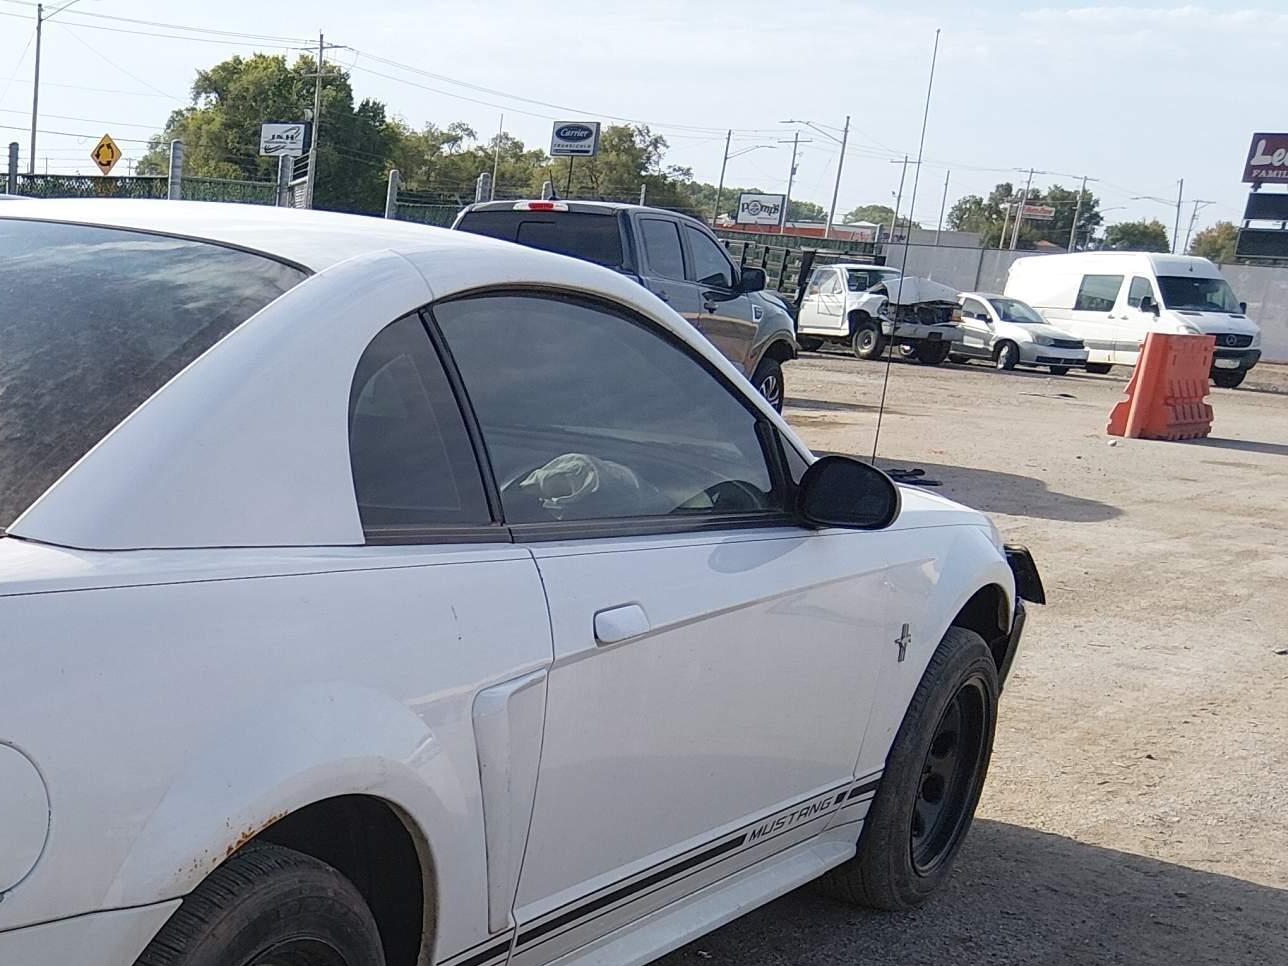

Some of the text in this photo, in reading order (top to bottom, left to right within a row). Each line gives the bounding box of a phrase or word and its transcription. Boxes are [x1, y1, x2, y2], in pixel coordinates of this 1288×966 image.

[560, 128, 589, 138] Carrier
[1250, 139, 1288, 167] Le
[748, 796, 834, 842] MUSTANG
